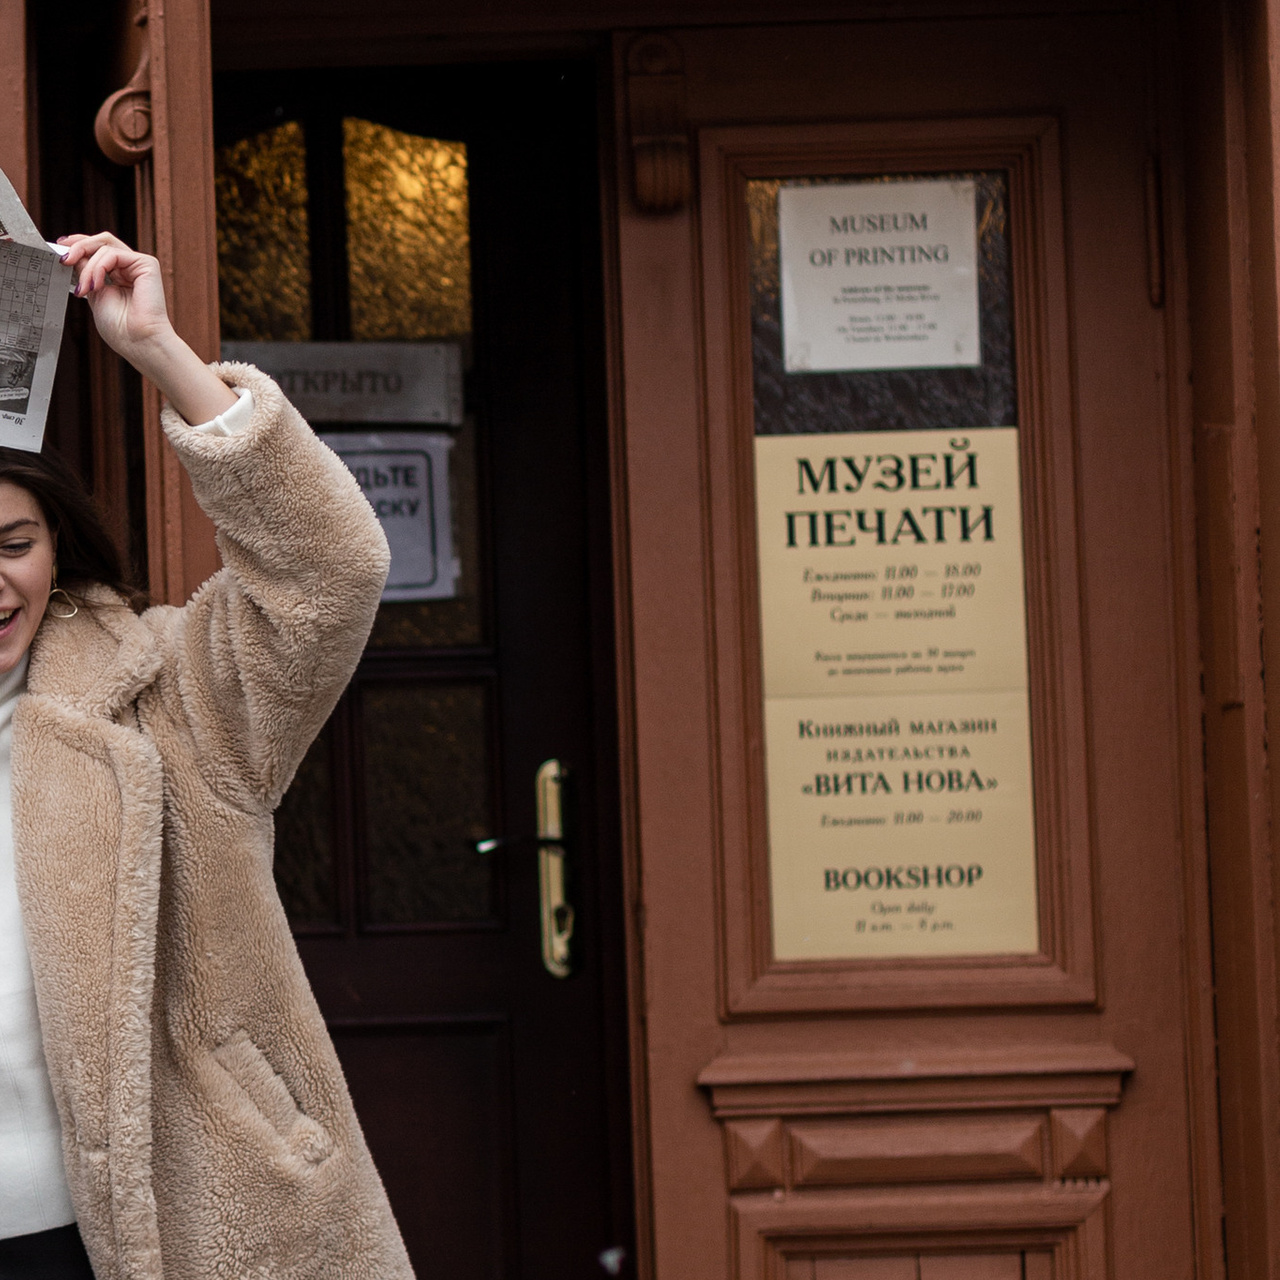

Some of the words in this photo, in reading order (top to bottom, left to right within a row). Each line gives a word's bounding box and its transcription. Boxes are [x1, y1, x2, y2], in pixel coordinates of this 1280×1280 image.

[829, 212, 929, 235] MUSEUM
[809, 247, 836, 267] OF
[844, 243, 950, 267] PRINTING
[356, 465, 418, 491] ДЬТЕ
[795, 436, 980, 496] МУЗЕЙ
[375, 498, 421, 519] СКУ
[783, 504, 996, 549] ПЕЧАТИ
[801, 769, 894, 797] «ВИТА
[901, 767, 999, 795] НОВА»
[823, 862, 984, 893] BOOKSHOP
